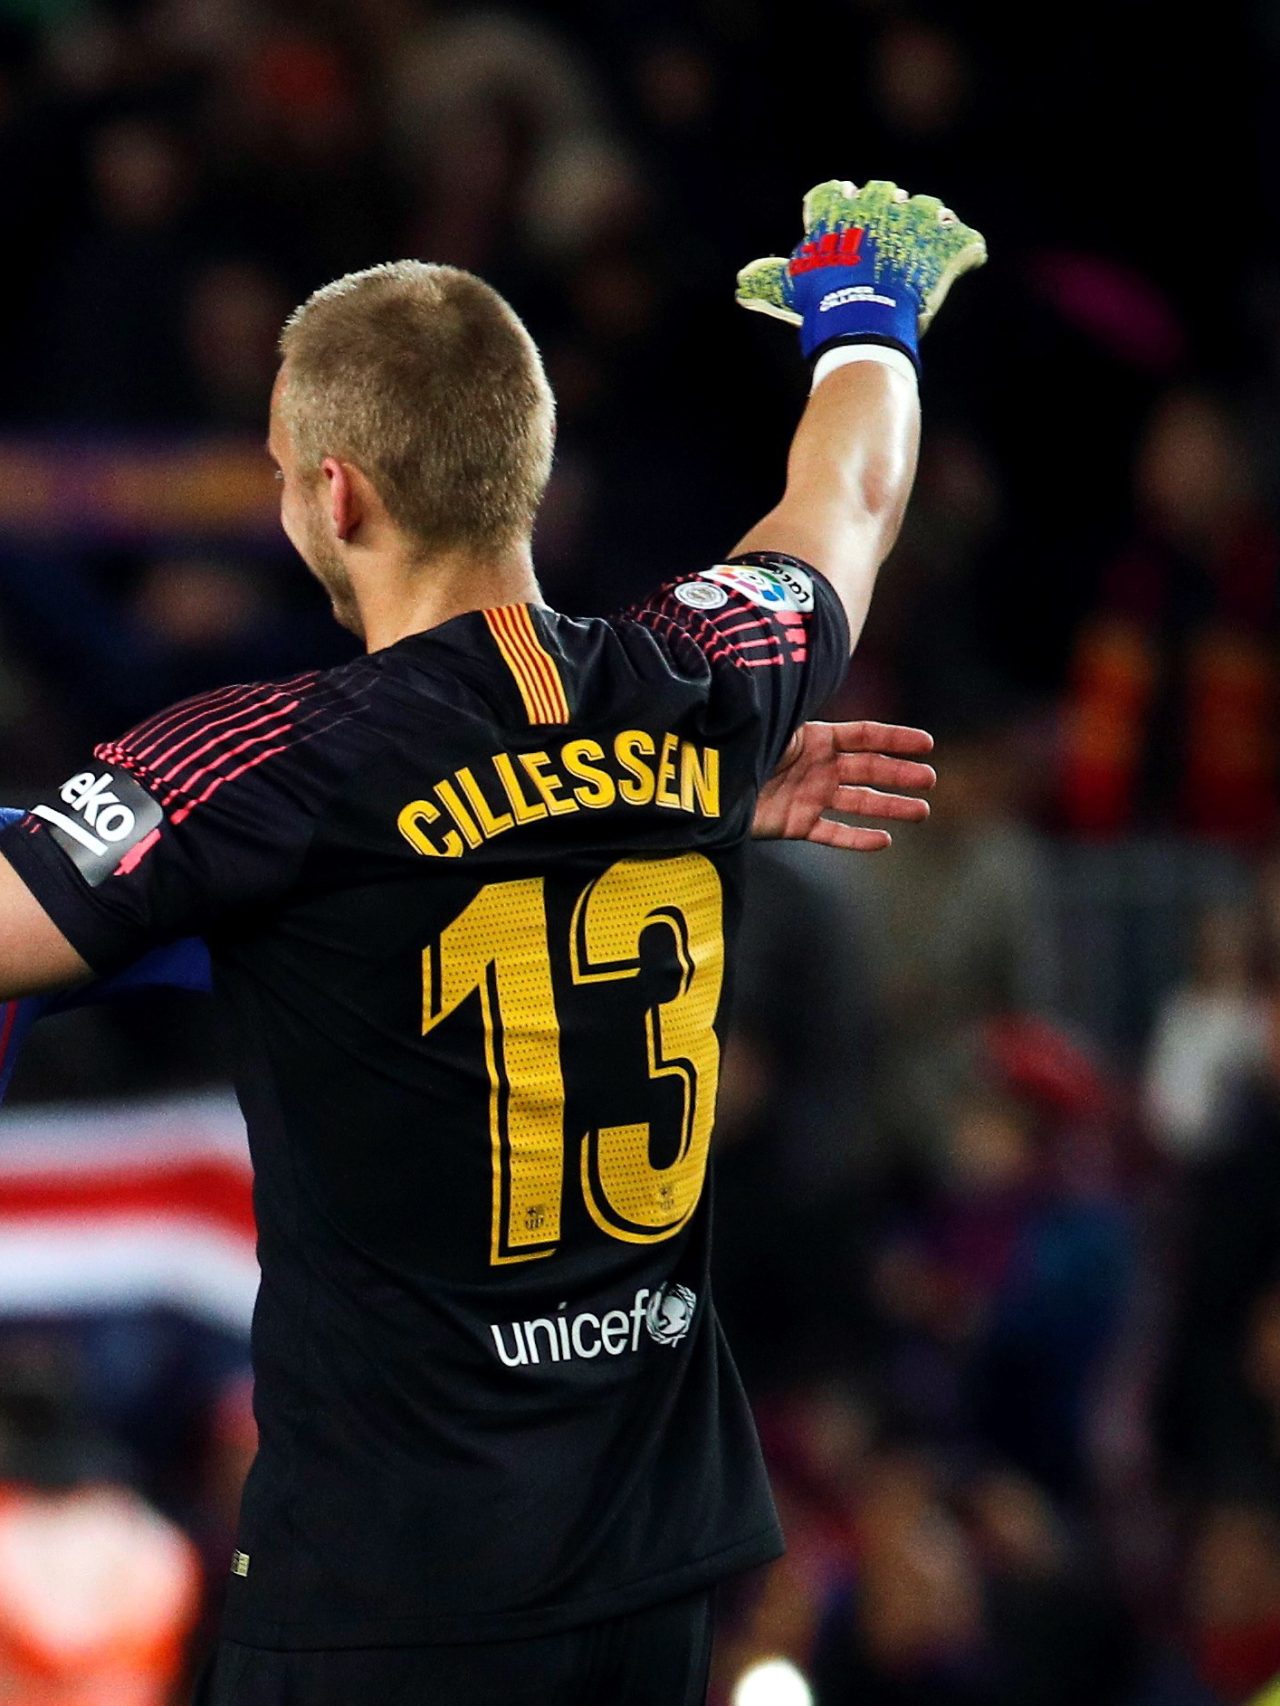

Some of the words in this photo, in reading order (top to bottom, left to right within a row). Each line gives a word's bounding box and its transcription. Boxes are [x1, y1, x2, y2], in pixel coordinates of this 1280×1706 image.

[59, 771, 136, 843] eko
[397, 729, 720, 858] CILLESSEN
[421, 851, 725, 1267] 13
[490, 1288, 650, 1367] unicef
